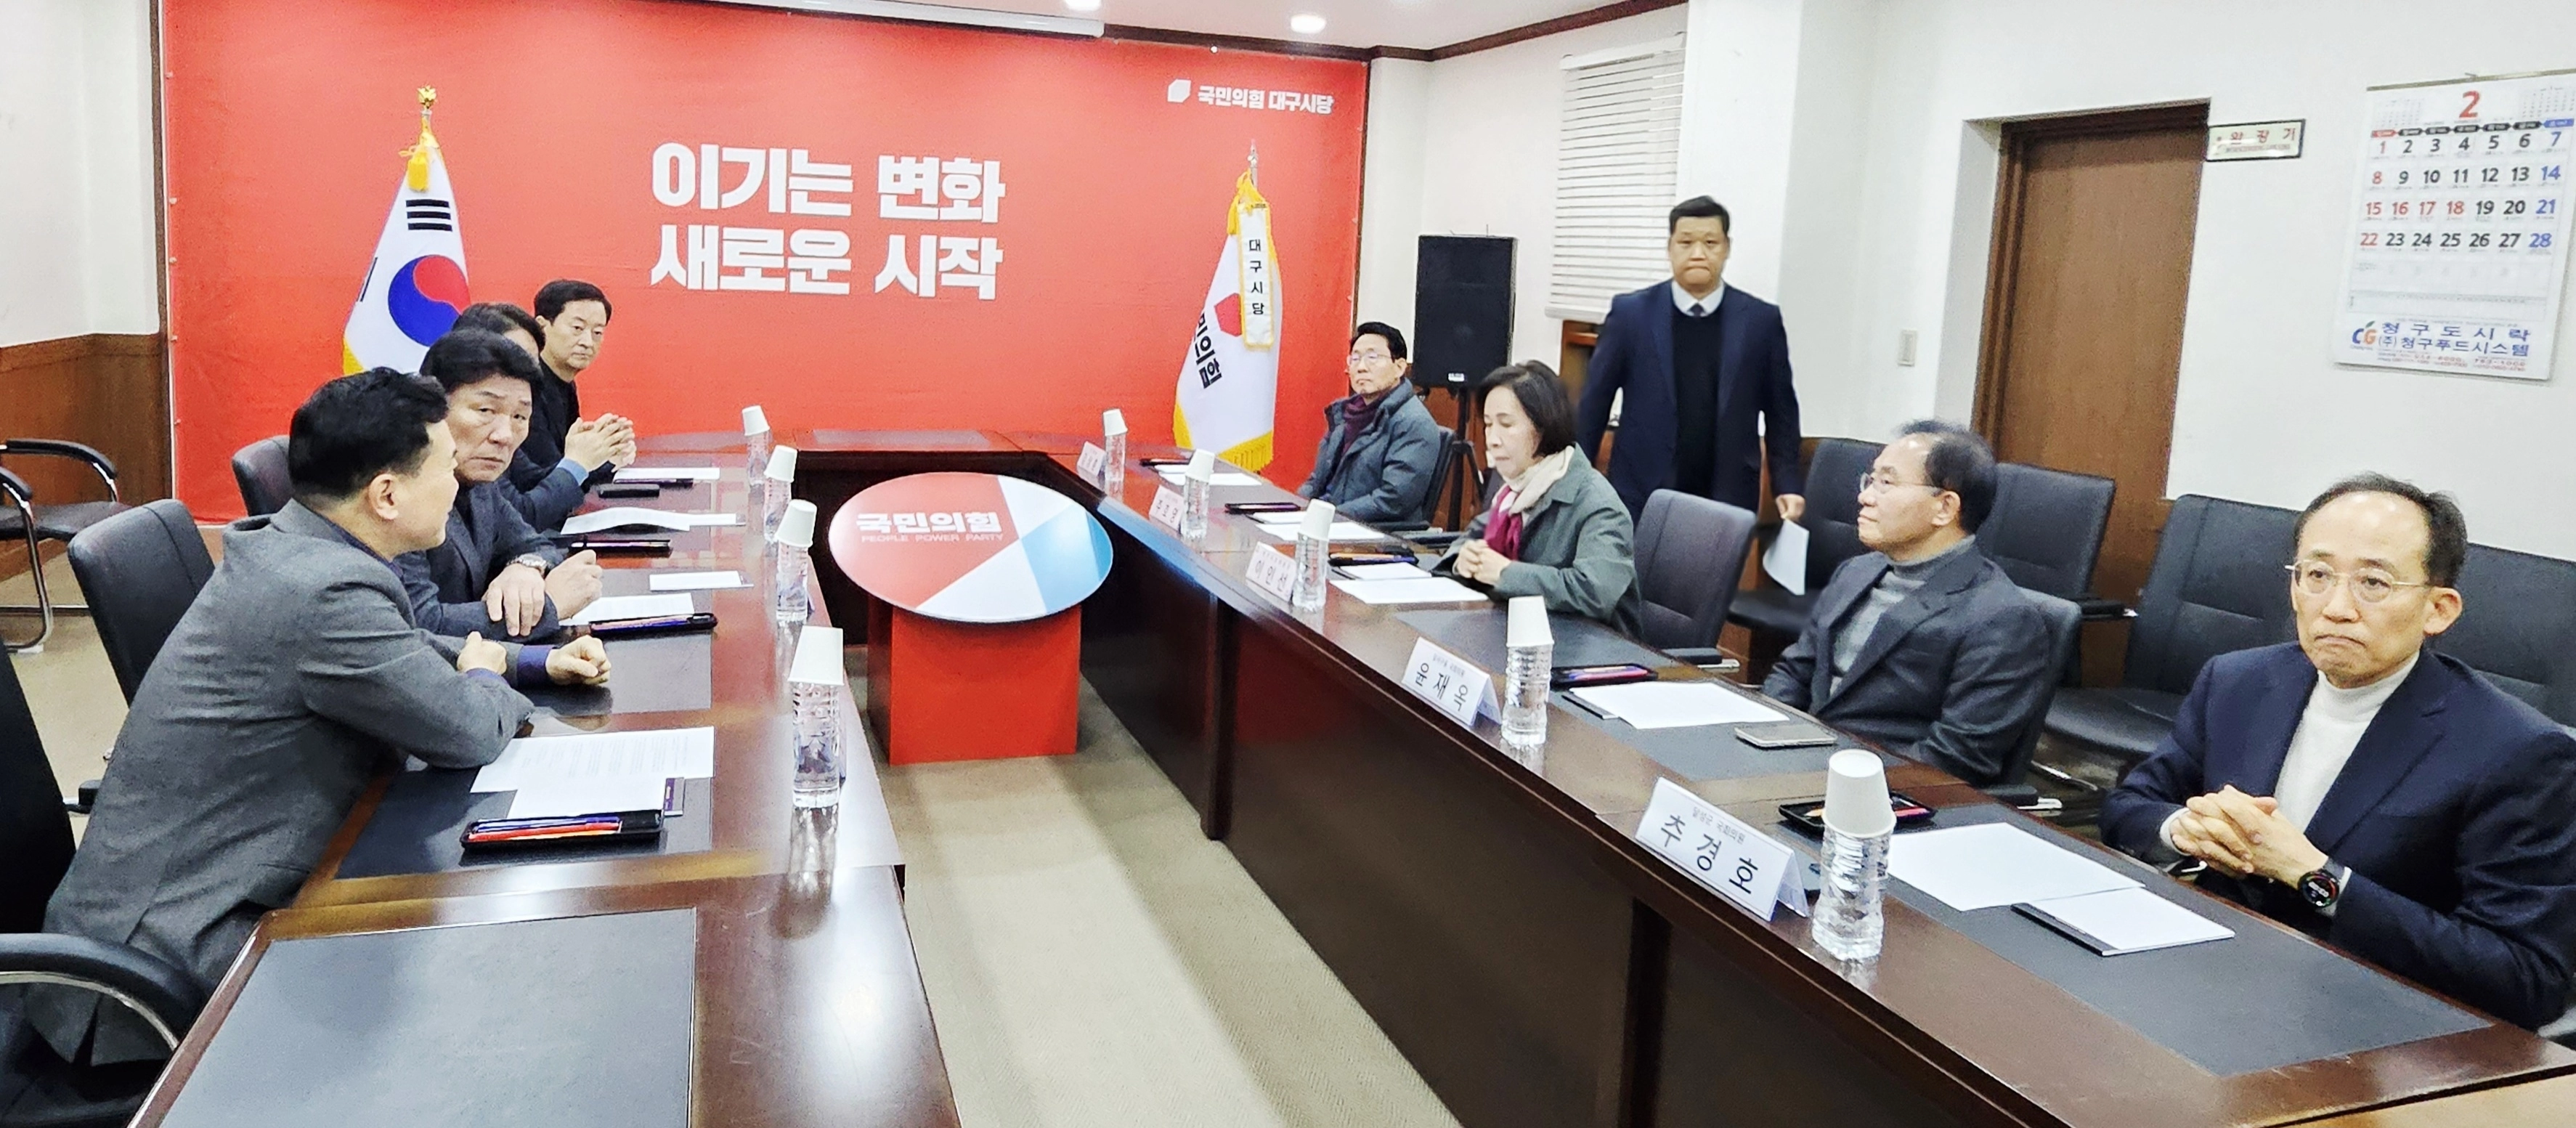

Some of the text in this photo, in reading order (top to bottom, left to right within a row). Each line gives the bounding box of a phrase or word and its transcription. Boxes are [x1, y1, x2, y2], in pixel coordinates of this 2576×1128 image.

[1198, 85, 1335, 114] 국민의힘 대구시당
[2458, 90, 2481, 118] 2
[2379, 131, 2561, 154] 1 2 3 4 5 6 7
[651, 142, 1006, 223] 이기는 변화
[2372, 165, 2561, 184] 8 9 10 11 12 13 14
[2366, 199, 2556, 215] 15 16 17 18 19 20 21
[2360, 232, 2553, 248] 22 23 24 25 26 27 28
[650, 224, 1004, 300] 새로운 시작
[1248, 238, 1265, 315] 대구시당
[856, 511, 1002, 534] 국민의힘
[861, 534, 909, 543] PEOPLE
[1415, 662, 1468, 712] 윤재옥
[1660, 814, 1759, 894] 추경호
